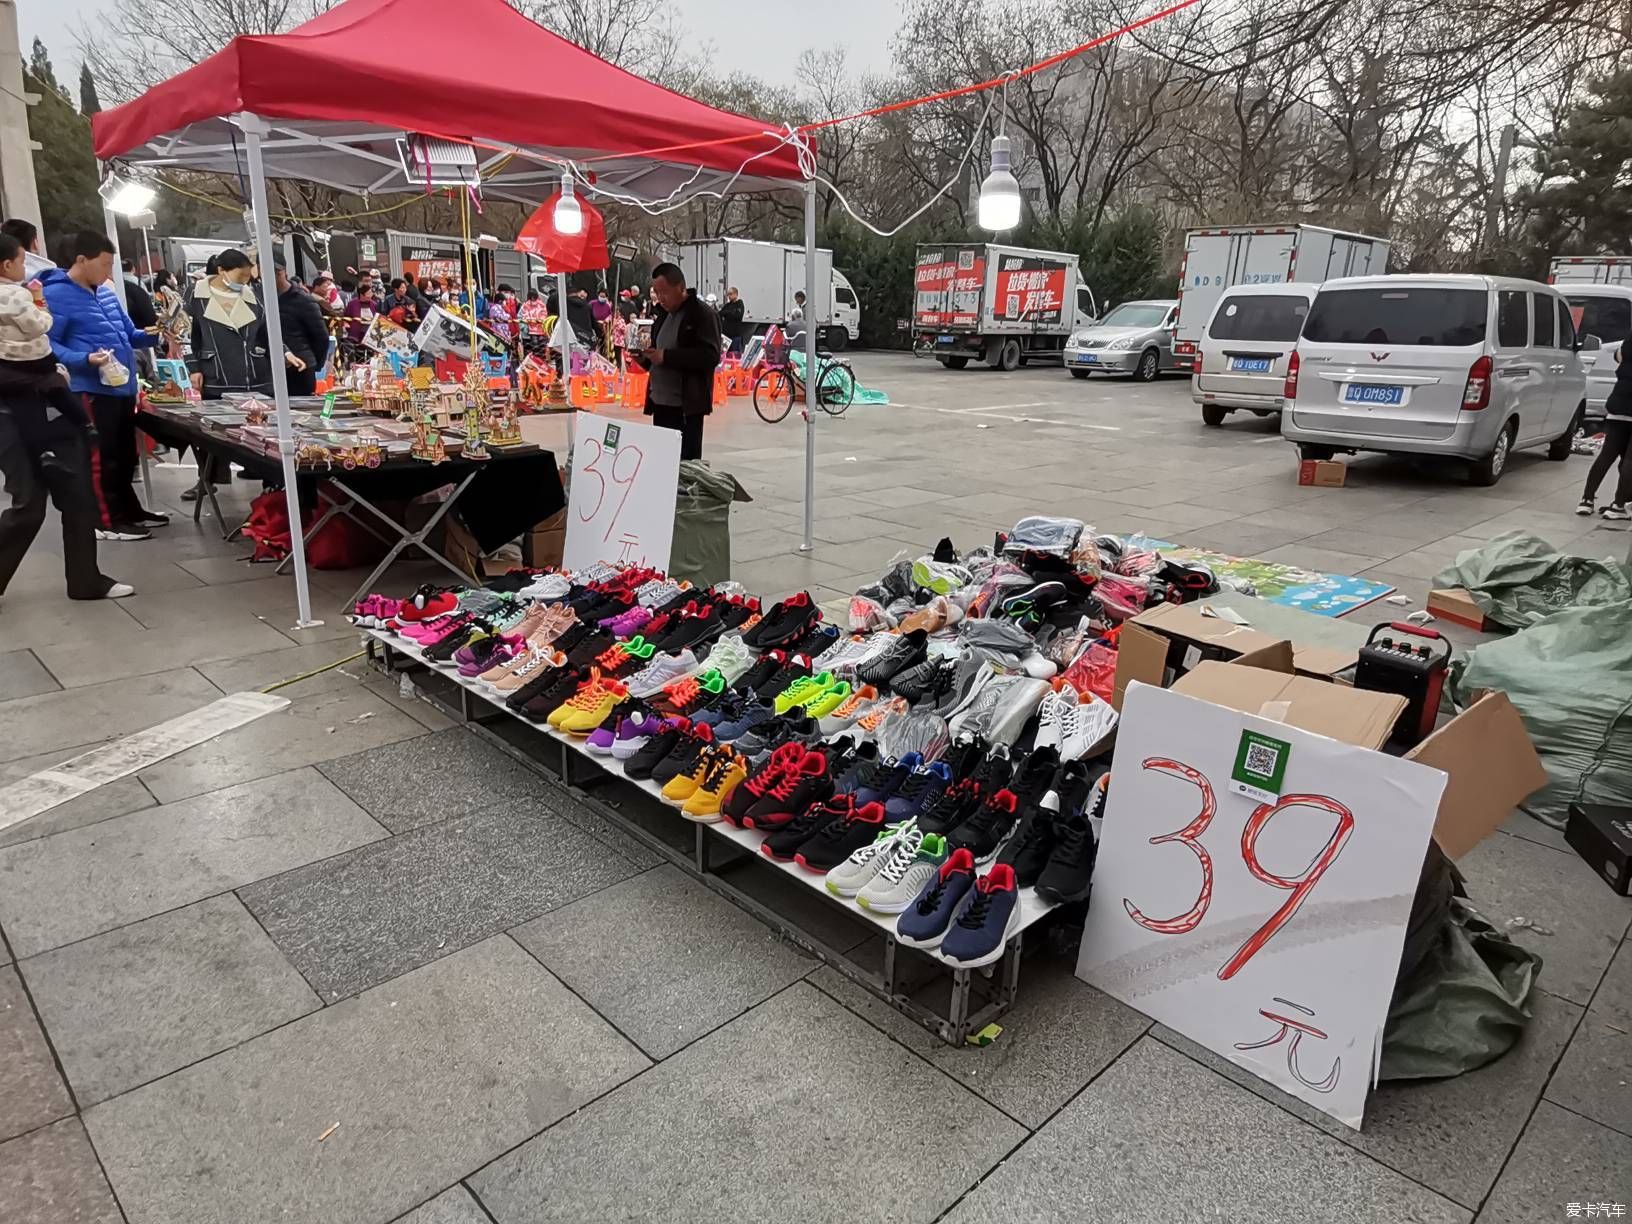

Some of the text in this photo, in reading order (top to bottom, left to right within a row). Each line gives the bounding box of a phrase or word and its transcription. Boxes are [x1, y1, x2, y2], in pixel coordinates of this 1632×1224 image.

[579, 438, 643, 543] 39
[1124, 757, 1354, 980] 39
[1234, 998, 1341, 1093] 元
